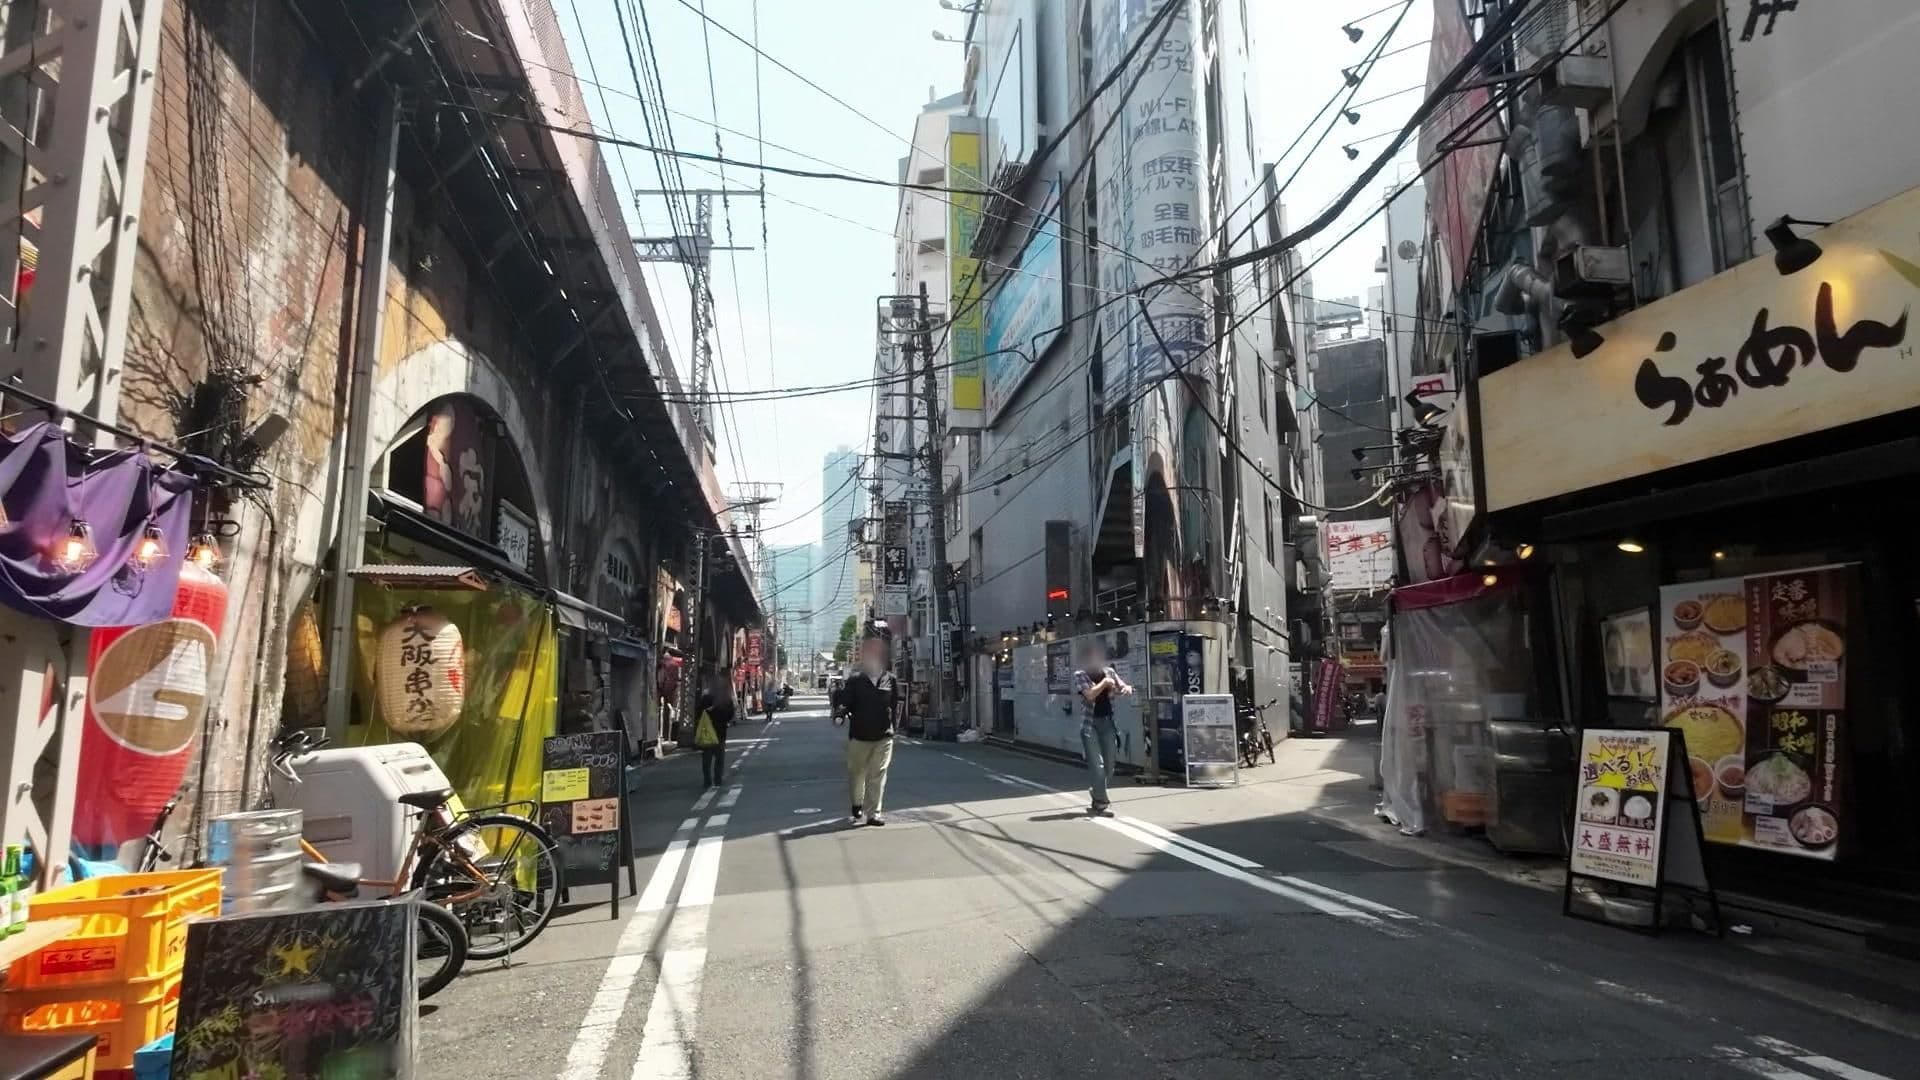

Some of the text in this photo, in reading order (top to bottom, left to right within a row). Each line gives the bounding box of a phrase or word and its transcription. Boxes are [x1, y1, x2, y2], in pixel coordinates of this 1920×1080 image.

[1153, 202, 1190, 222] 全室
[1634, 281, 1910, 426] らぁめん
[1581, 829, 1651, 858] 大盛無料
